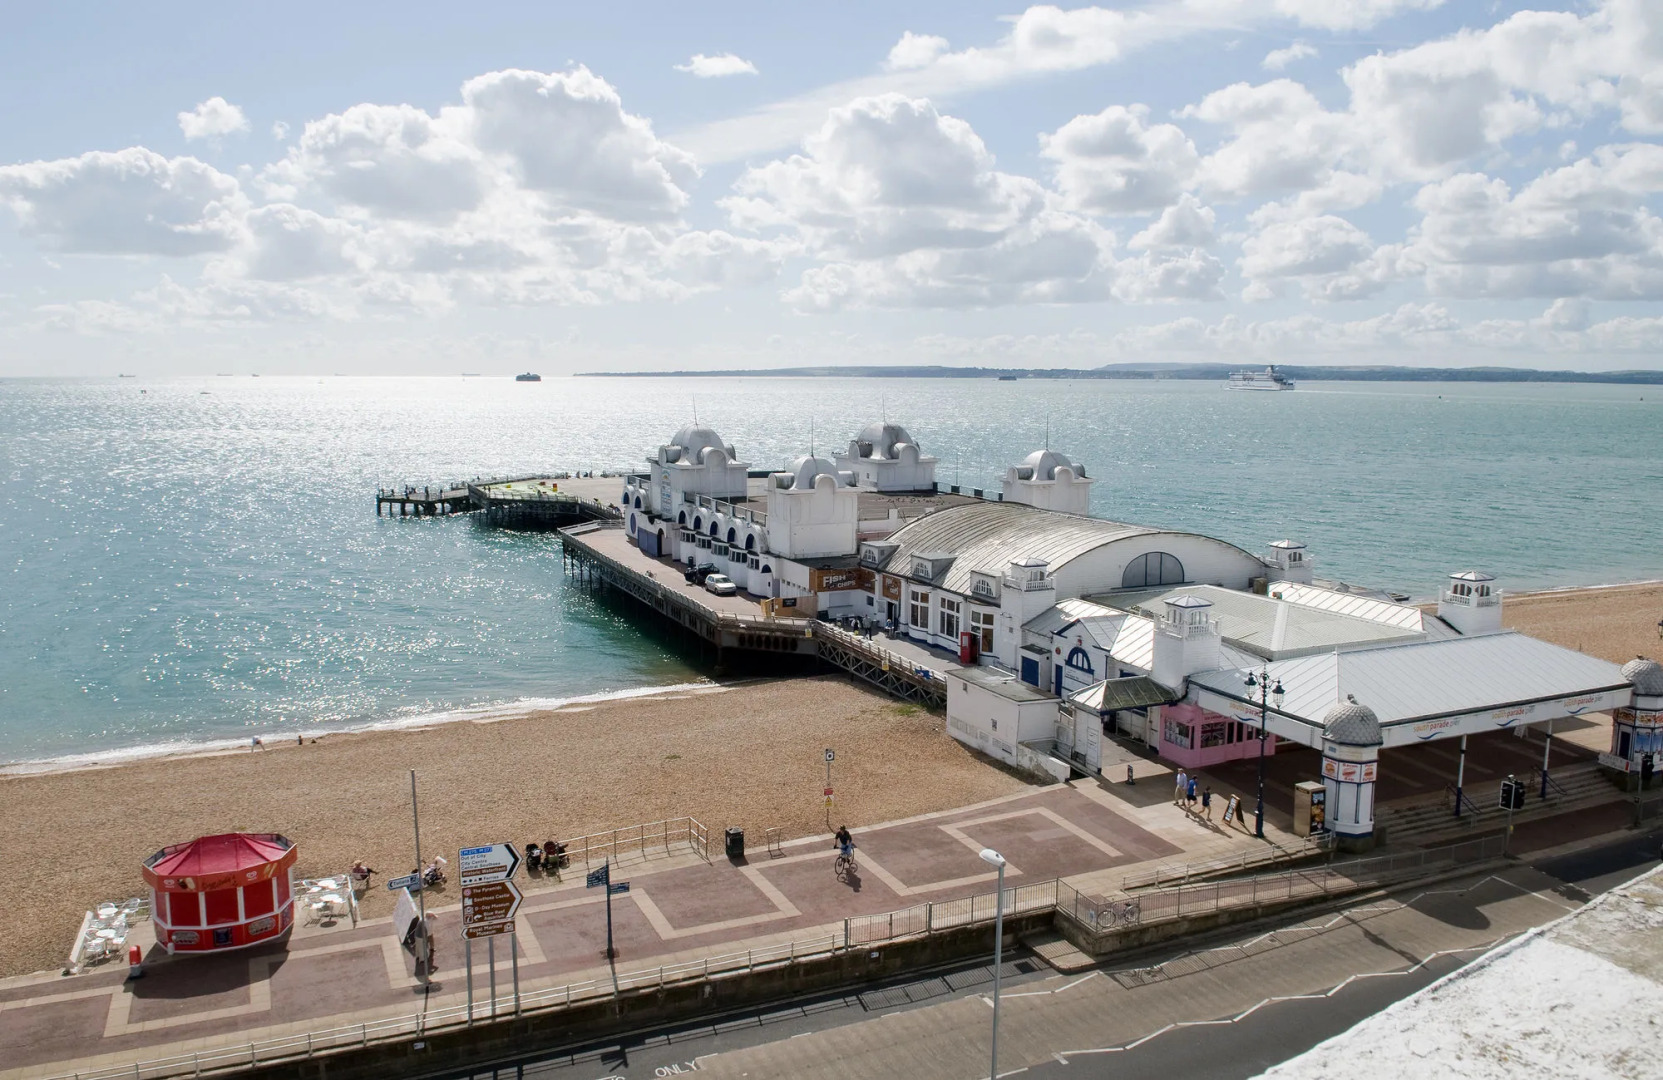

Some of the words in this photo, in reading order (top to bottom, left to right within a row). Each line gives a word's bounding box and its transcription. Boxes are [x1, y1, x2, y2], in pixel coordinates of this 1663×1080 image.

[823, 575, 846, 588] FISH
[837, 580, 856, 588] CHIPS
[1577, 697, 1594, 706] parade
[1507, 707, 1524, 718] parade
[1413, 724, 1428, 732] south
[1430, 721, 1449, 731] parade
[655, 1060, 697, 1077] ONLY
